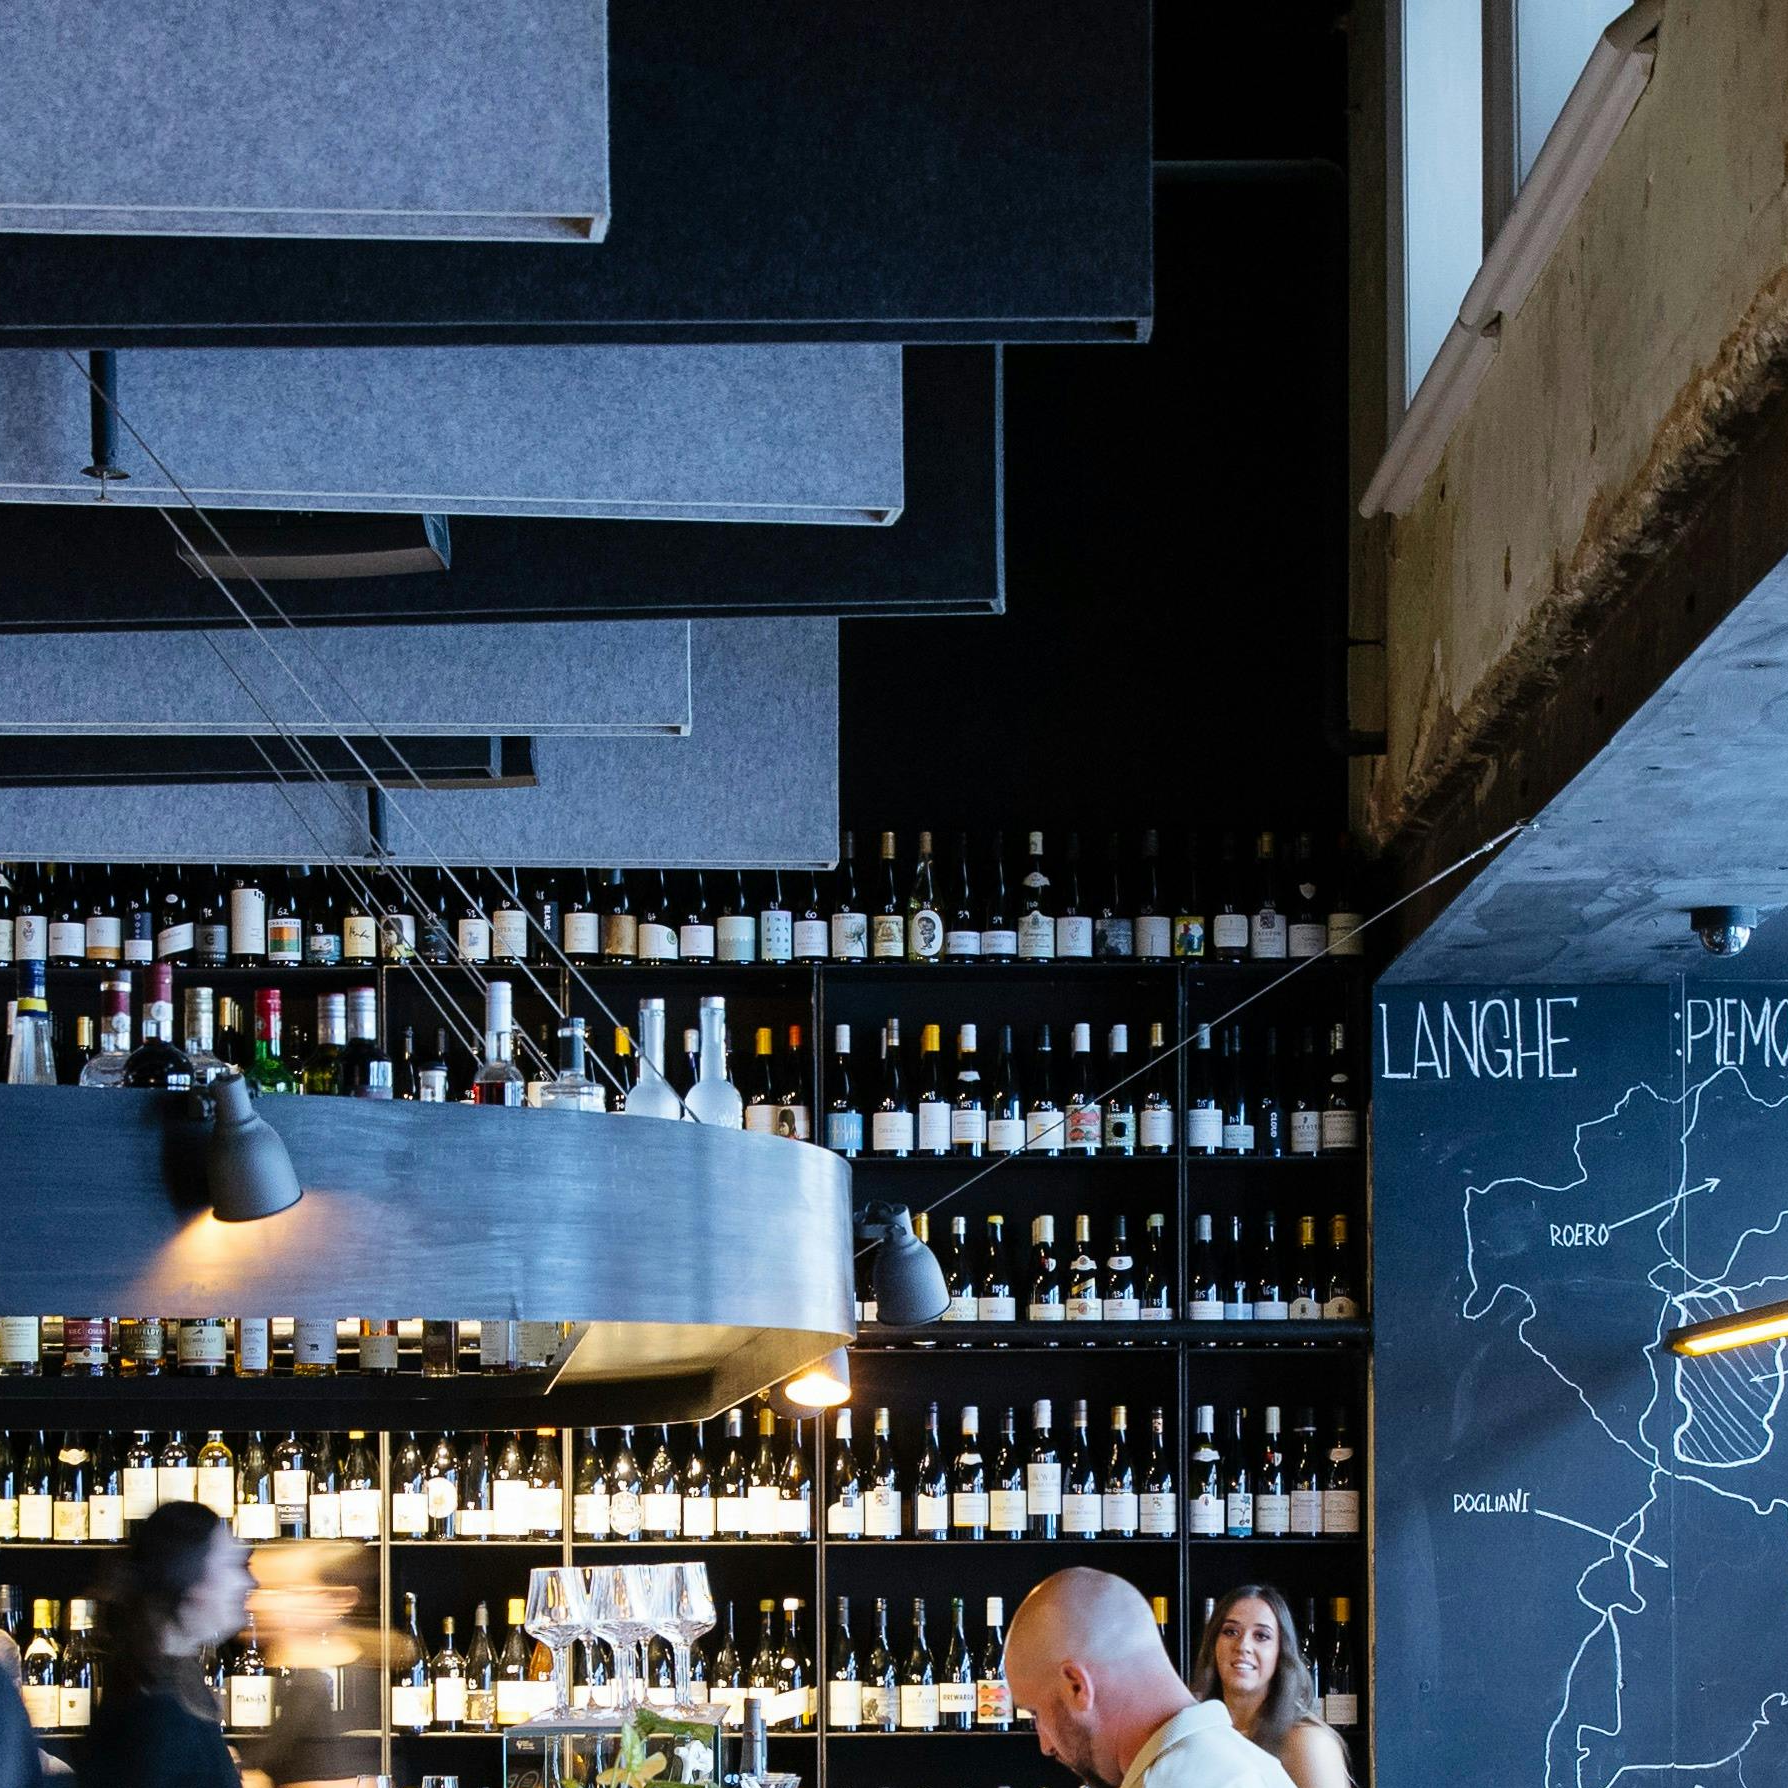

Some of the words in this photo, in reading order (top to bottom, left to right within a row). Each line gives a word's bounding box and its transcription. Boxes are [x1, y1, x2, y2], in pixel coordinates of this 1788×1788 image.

[1379, 997, 1577, 1079] LANGHE
[1550, 1223, 1610, 1247] ROERO
[1453, 1487, 1529, 1514] DOGLIANI
